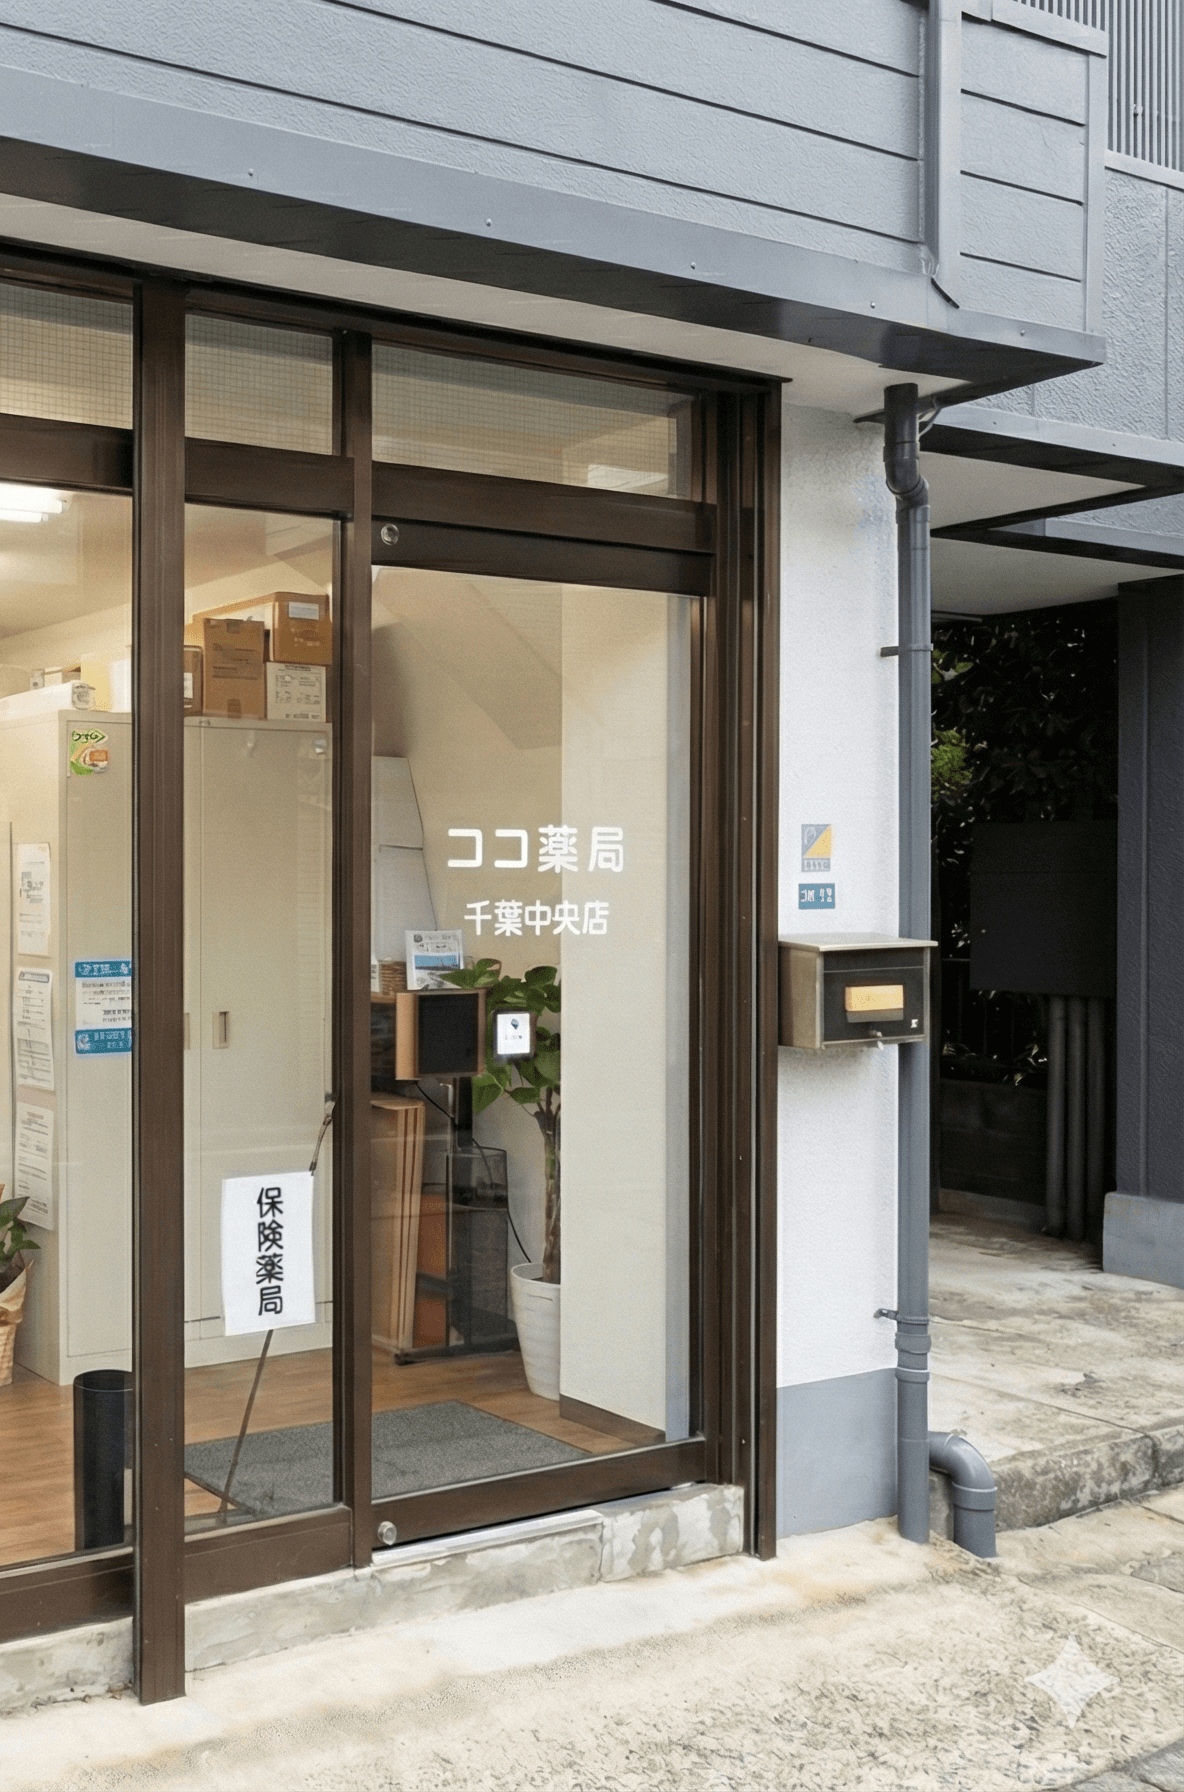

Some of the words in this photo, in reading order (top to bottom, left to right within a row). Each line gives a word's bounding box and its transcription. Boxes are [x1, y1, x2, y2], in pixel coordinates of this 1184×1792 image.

[447, 824, 624, 873] ココ薬局
[464, 899, 610, 936] 千葉中央店
[256, 1186, 283, 1316] 保険薬局
